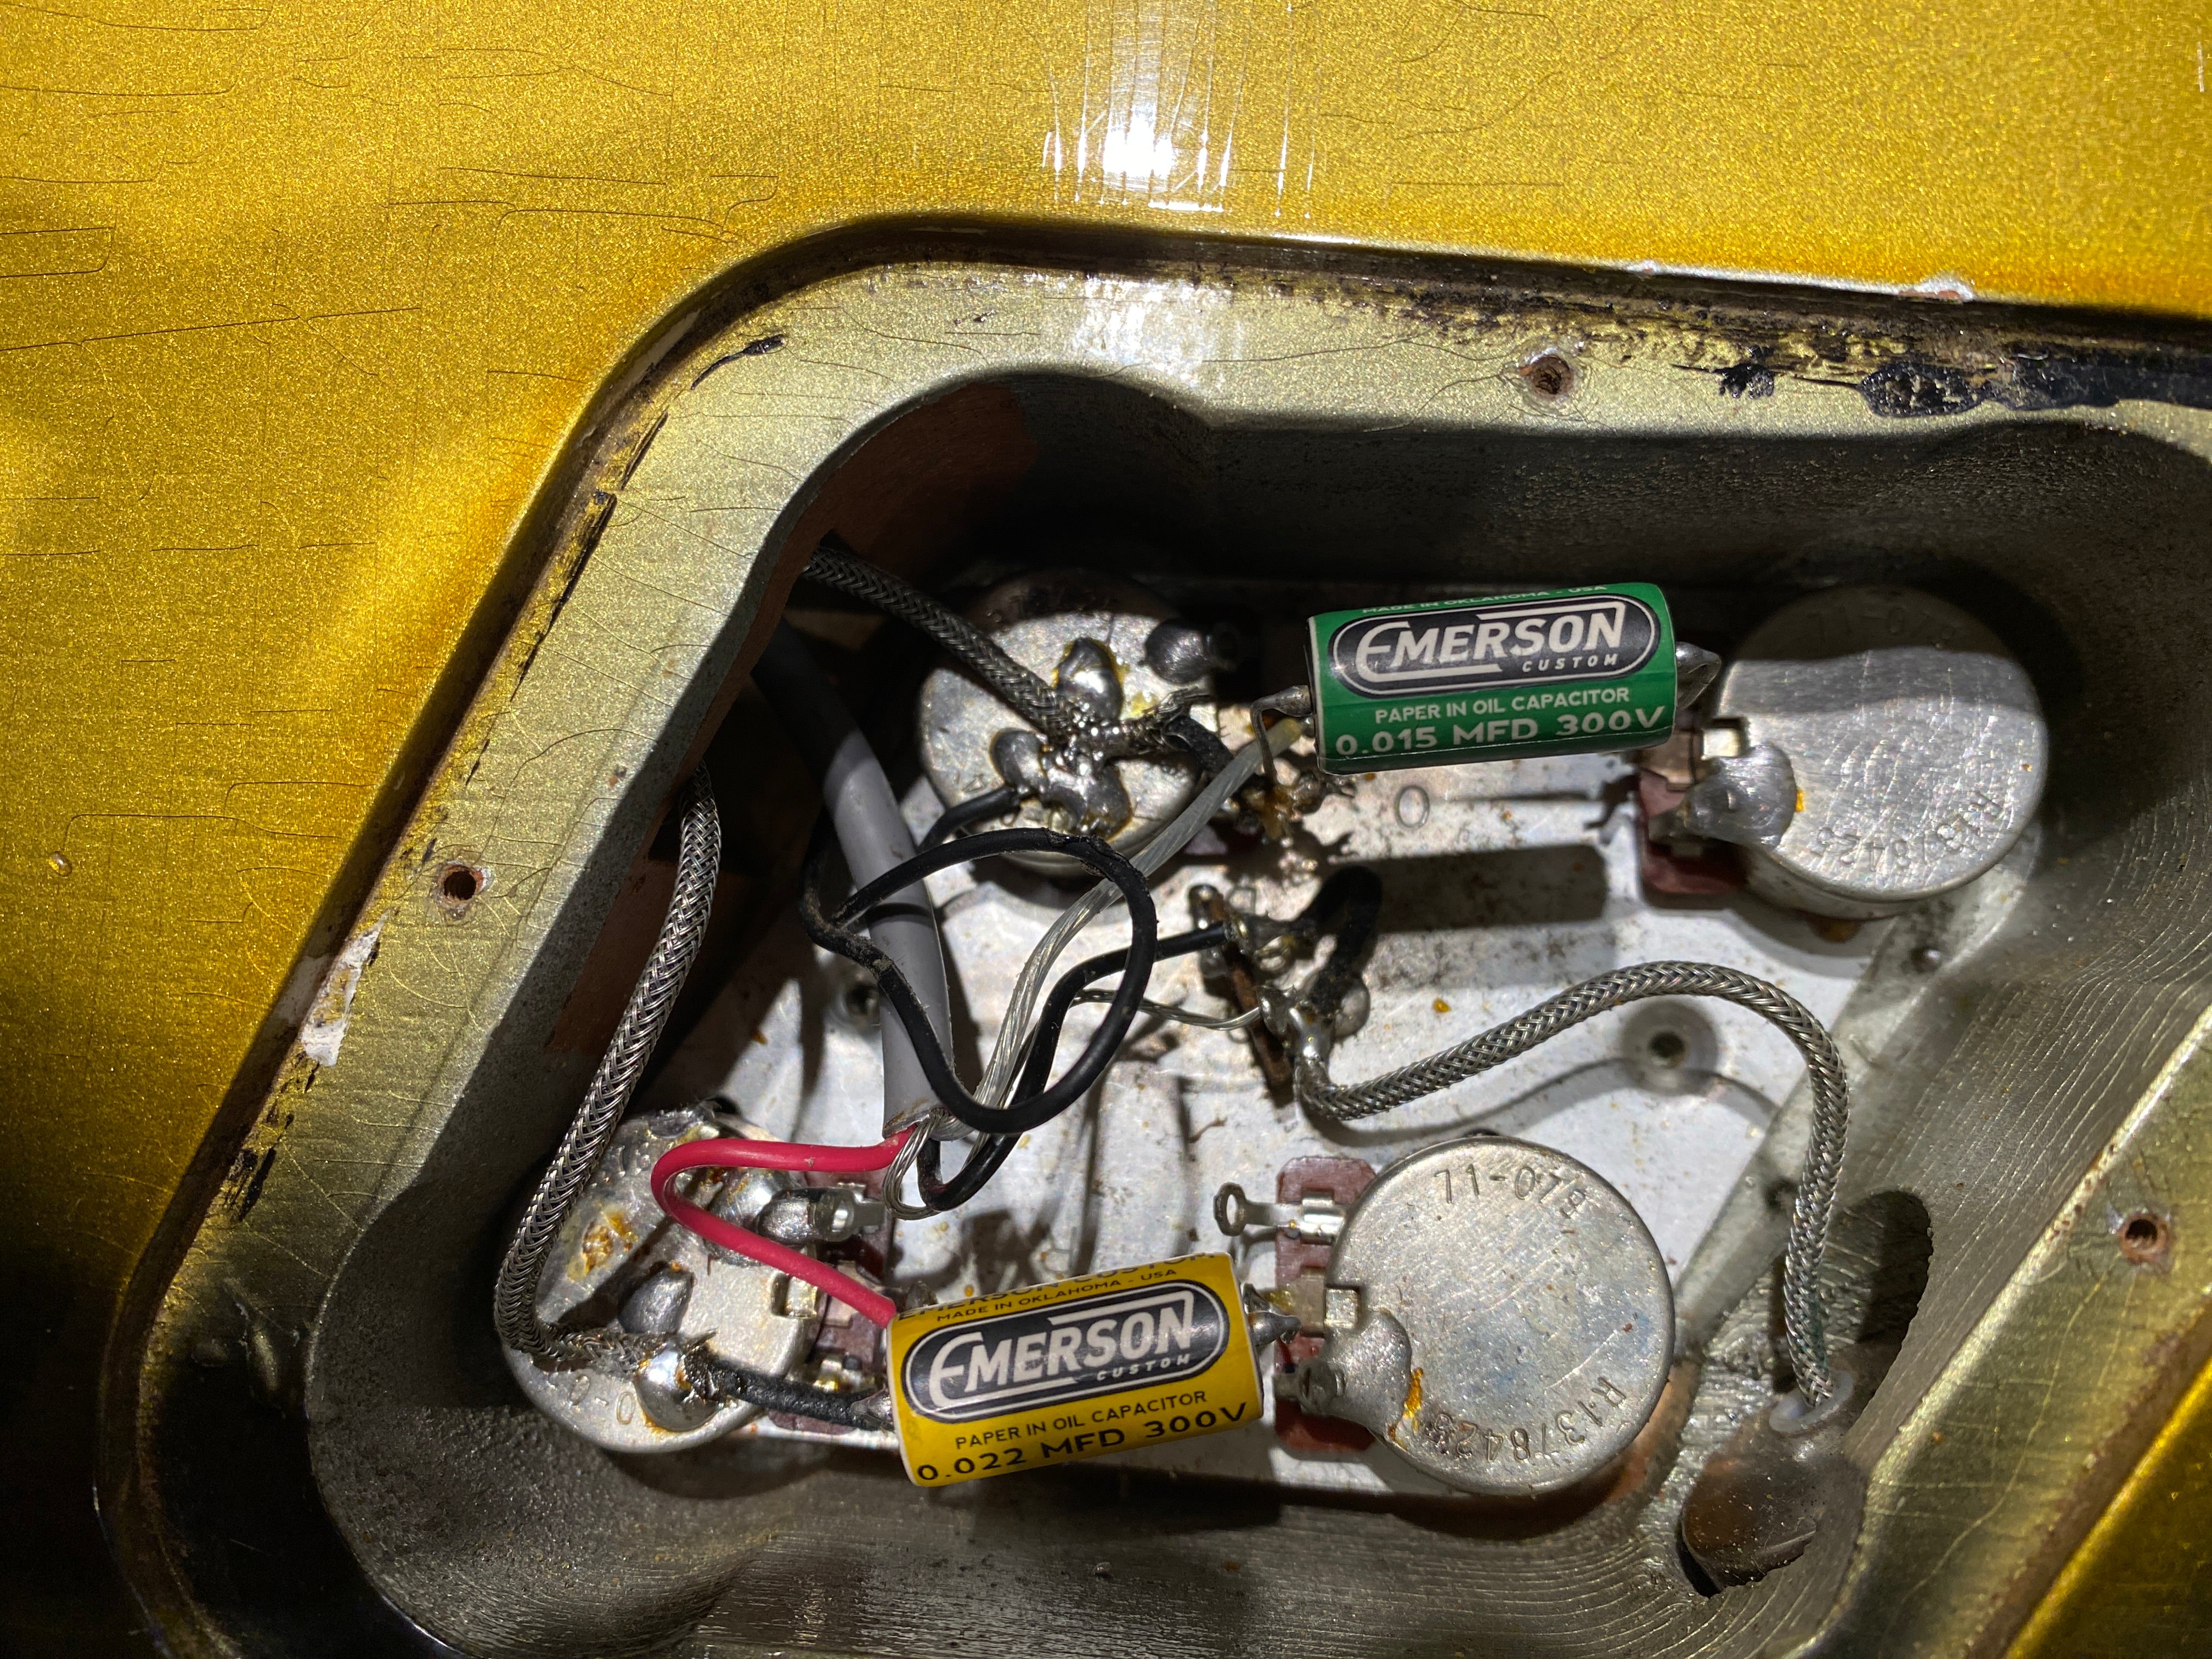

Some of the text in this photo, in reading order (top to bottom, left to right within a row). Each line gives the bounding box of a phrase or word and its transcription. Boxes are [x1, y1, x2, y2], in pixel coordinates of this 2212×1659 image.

[1362, 604, 1415, 613] MADE
[1443, 591, 1551, 605] OKLAHOMA
[1356, 601, 1626, 682] EMERSON
[1522, 653, 1618, 673] CUSTOM
[1335, 706, 1666, 756] 0.015 MFD 300V
[1375, 687, 1630, 724] PAPER IN OIL CAPACITOR
[936, 1306, 988, 1322] MADE
[995, 1301, 1012, 1311] IN
[1018, 1280, 1121, 1305] OKLAHOMA
[1141, 1269, 1177, 1280] USA
[930, 1291, 1194, 1408] EMERSON
[1097, 1353, 1192, 1381] CUSTOM
[916, 1403, 1247, 1481] 0.022 MFD 300V
[955, 1391, 1207, 1450] PAPER IN OIL CAPACITOR
